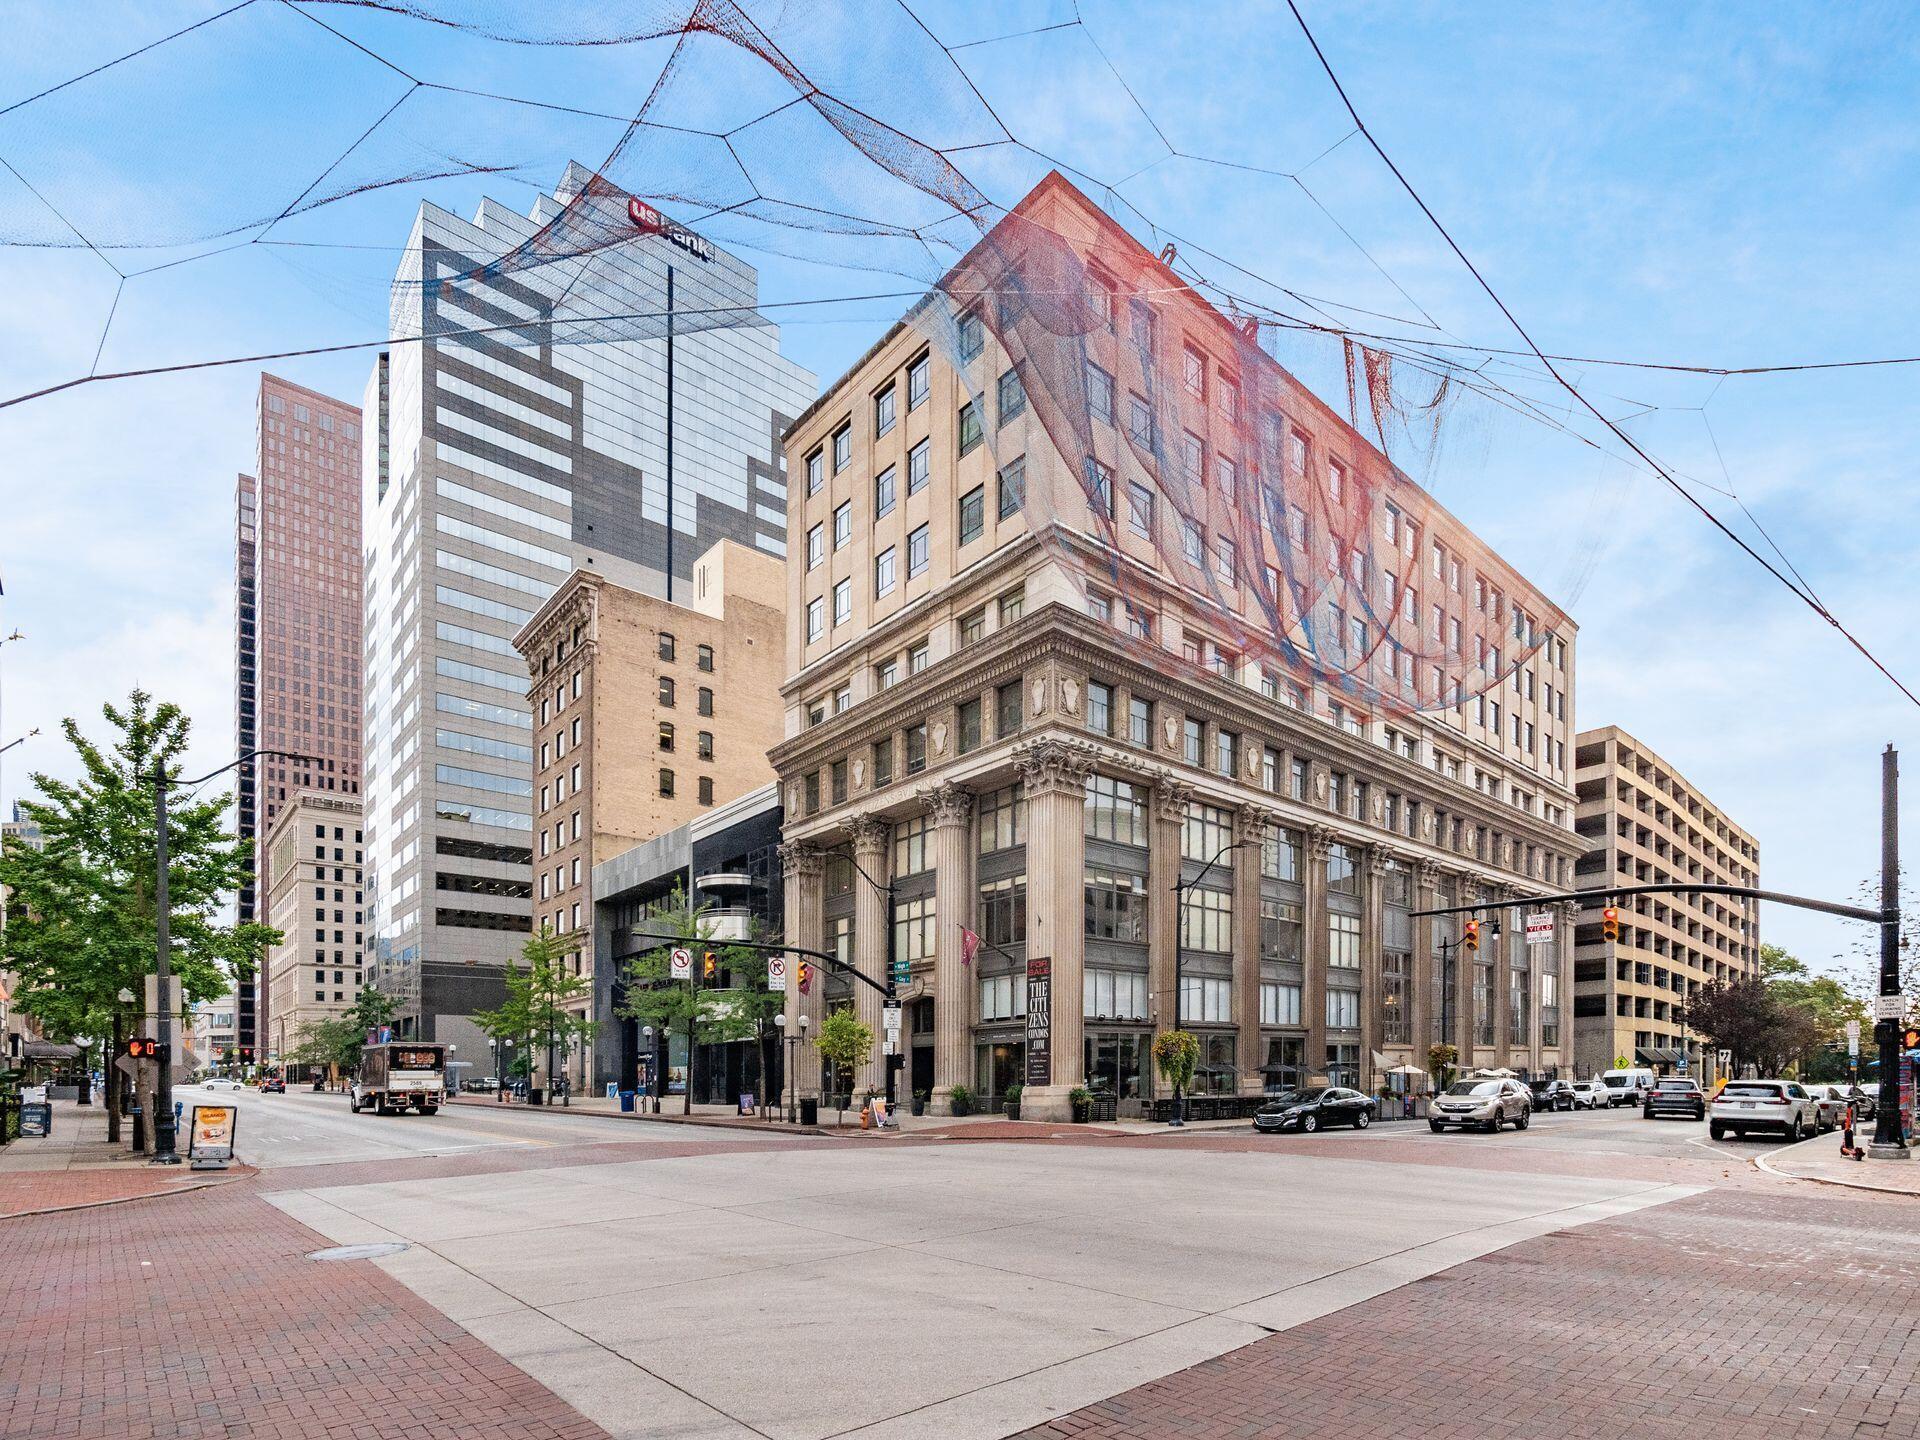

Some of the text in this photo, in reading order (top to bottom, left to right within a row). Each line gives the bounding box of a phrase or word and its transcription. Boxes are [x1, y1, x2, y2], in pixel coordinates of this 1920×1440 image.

[1030, 960, 1048, 968] FOR
[1027, 968, 1051, 976] SALE
[1029, 981, 1048, 997] THE
[1029, 997, 1047, 1012] CITI
[1028, 1012, 1049, 1028] ZENS
[1028, 1028, 1049, 1040] CONDOS
[1032, 1039, 1045, 1050] .COM
